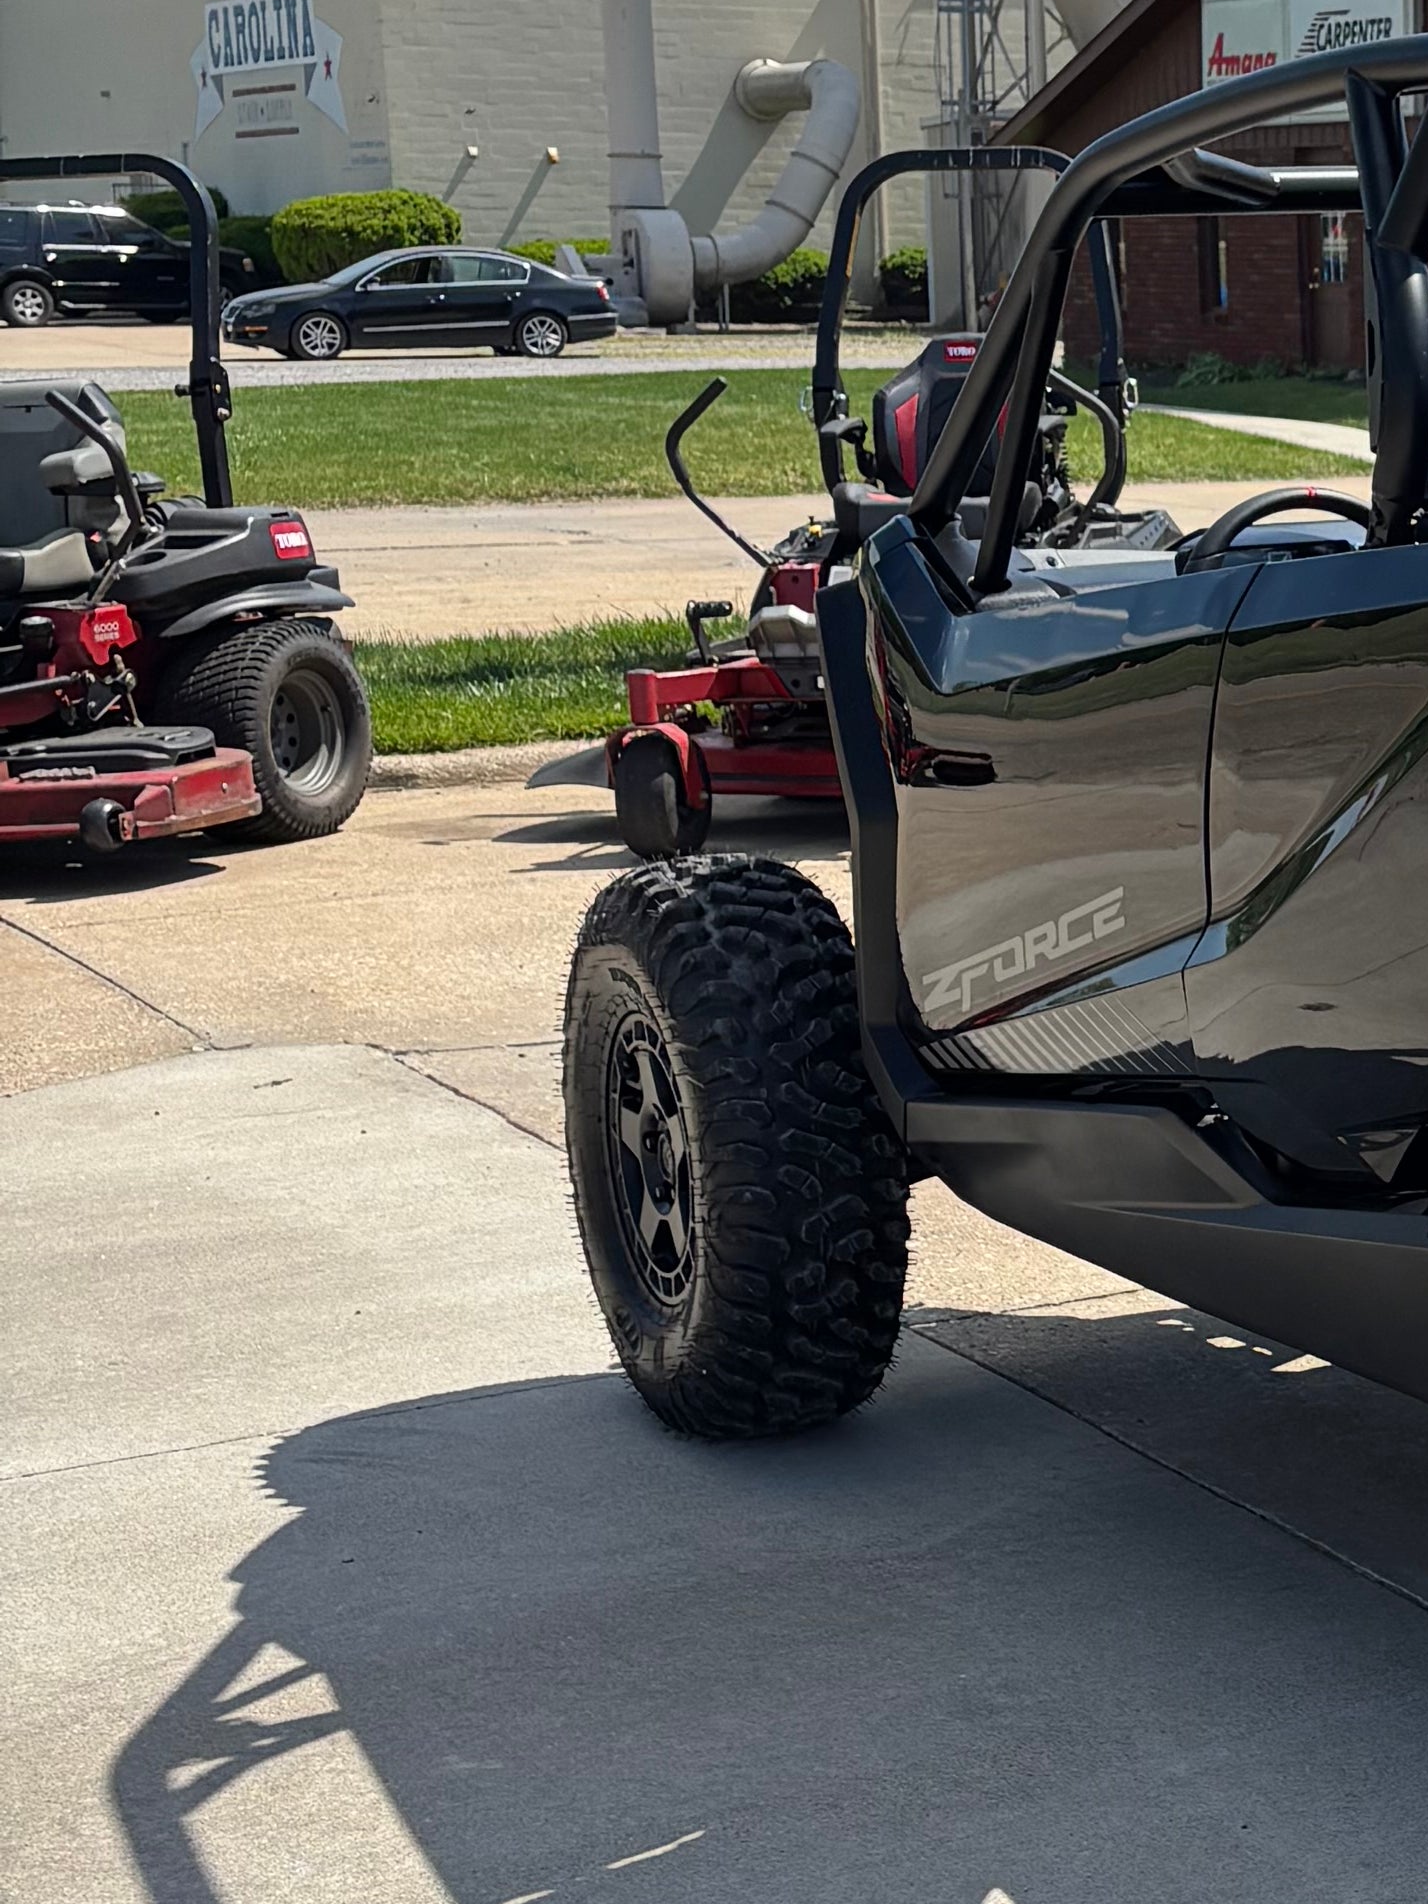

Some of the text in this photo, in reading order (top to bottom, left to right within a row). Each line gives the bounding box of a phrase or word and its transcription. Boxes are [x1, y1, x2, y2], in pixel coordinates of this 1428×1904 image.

[1315, 16, 1393, 51] CARPENTER
[1207, 32, 1278, 76] Amana
[946, 345, 977, 357] TORO
[274, 531, 308, 550] TORO
[93, 621, 120, 634] 6000
[921, 885, 1126, 1013] ZFORCE
